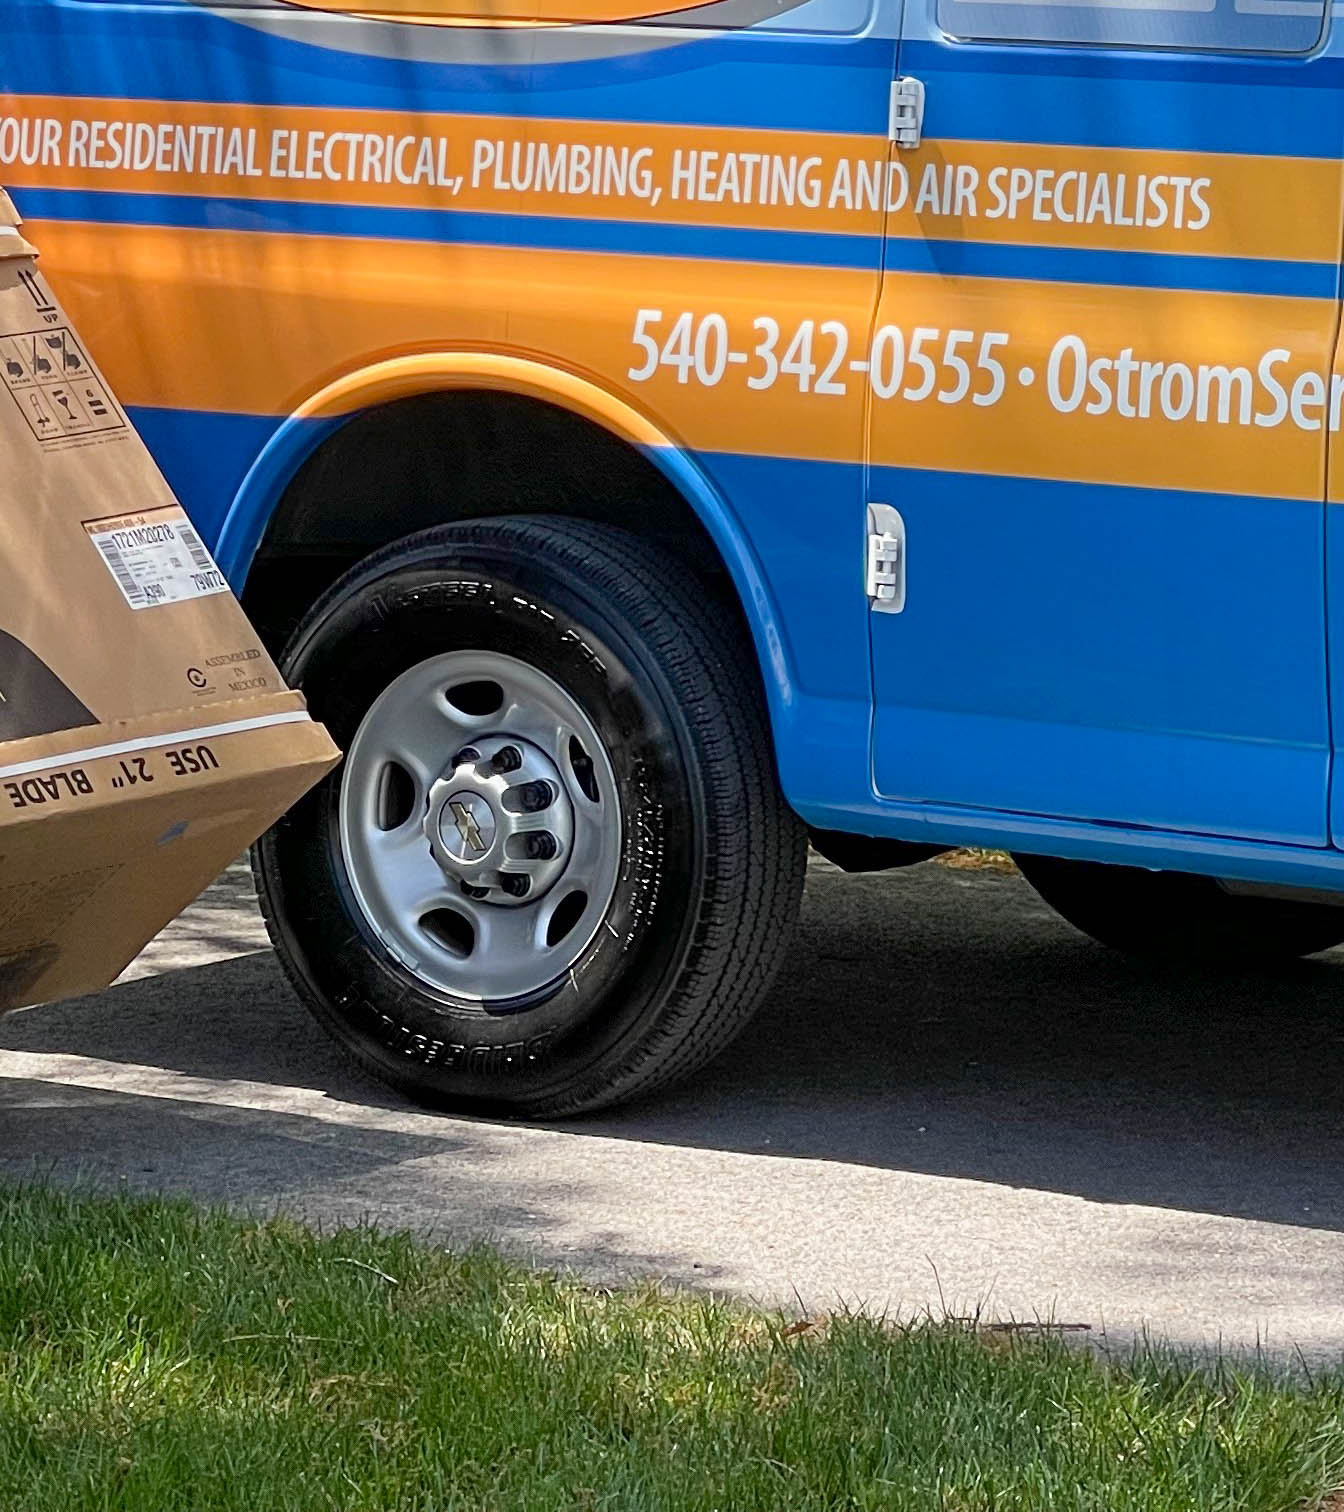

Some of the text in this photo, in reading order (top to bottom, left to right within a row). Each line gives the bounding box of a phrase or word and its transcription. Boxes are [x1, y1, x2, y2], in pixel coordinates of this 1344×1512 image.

[68, 119, 262, 178] RESIDENTIAL
[270, 128, 465, 196] ELECTRICAL,
[472, 138, 662, 207] PLUMBING,
[672, 149, 823, 208] HEATING
[828, 157, 909, 213] AND
[915, 163, 978, 217] AIR
[985, 165, 1212, 231] SPECIALISTS
[43, 313, 59, 325] UP
[627, 308, 1005, 408] 540-342-0555
[112, 524, 175, 551] 1721M20278
[205, 649, 261, 667] ASSEMBLED
[228, 676, 267, 691] MEXICO
[233, 667, 246, 678] IN
[3, 745, 220, 808] USE 21" BLADE
